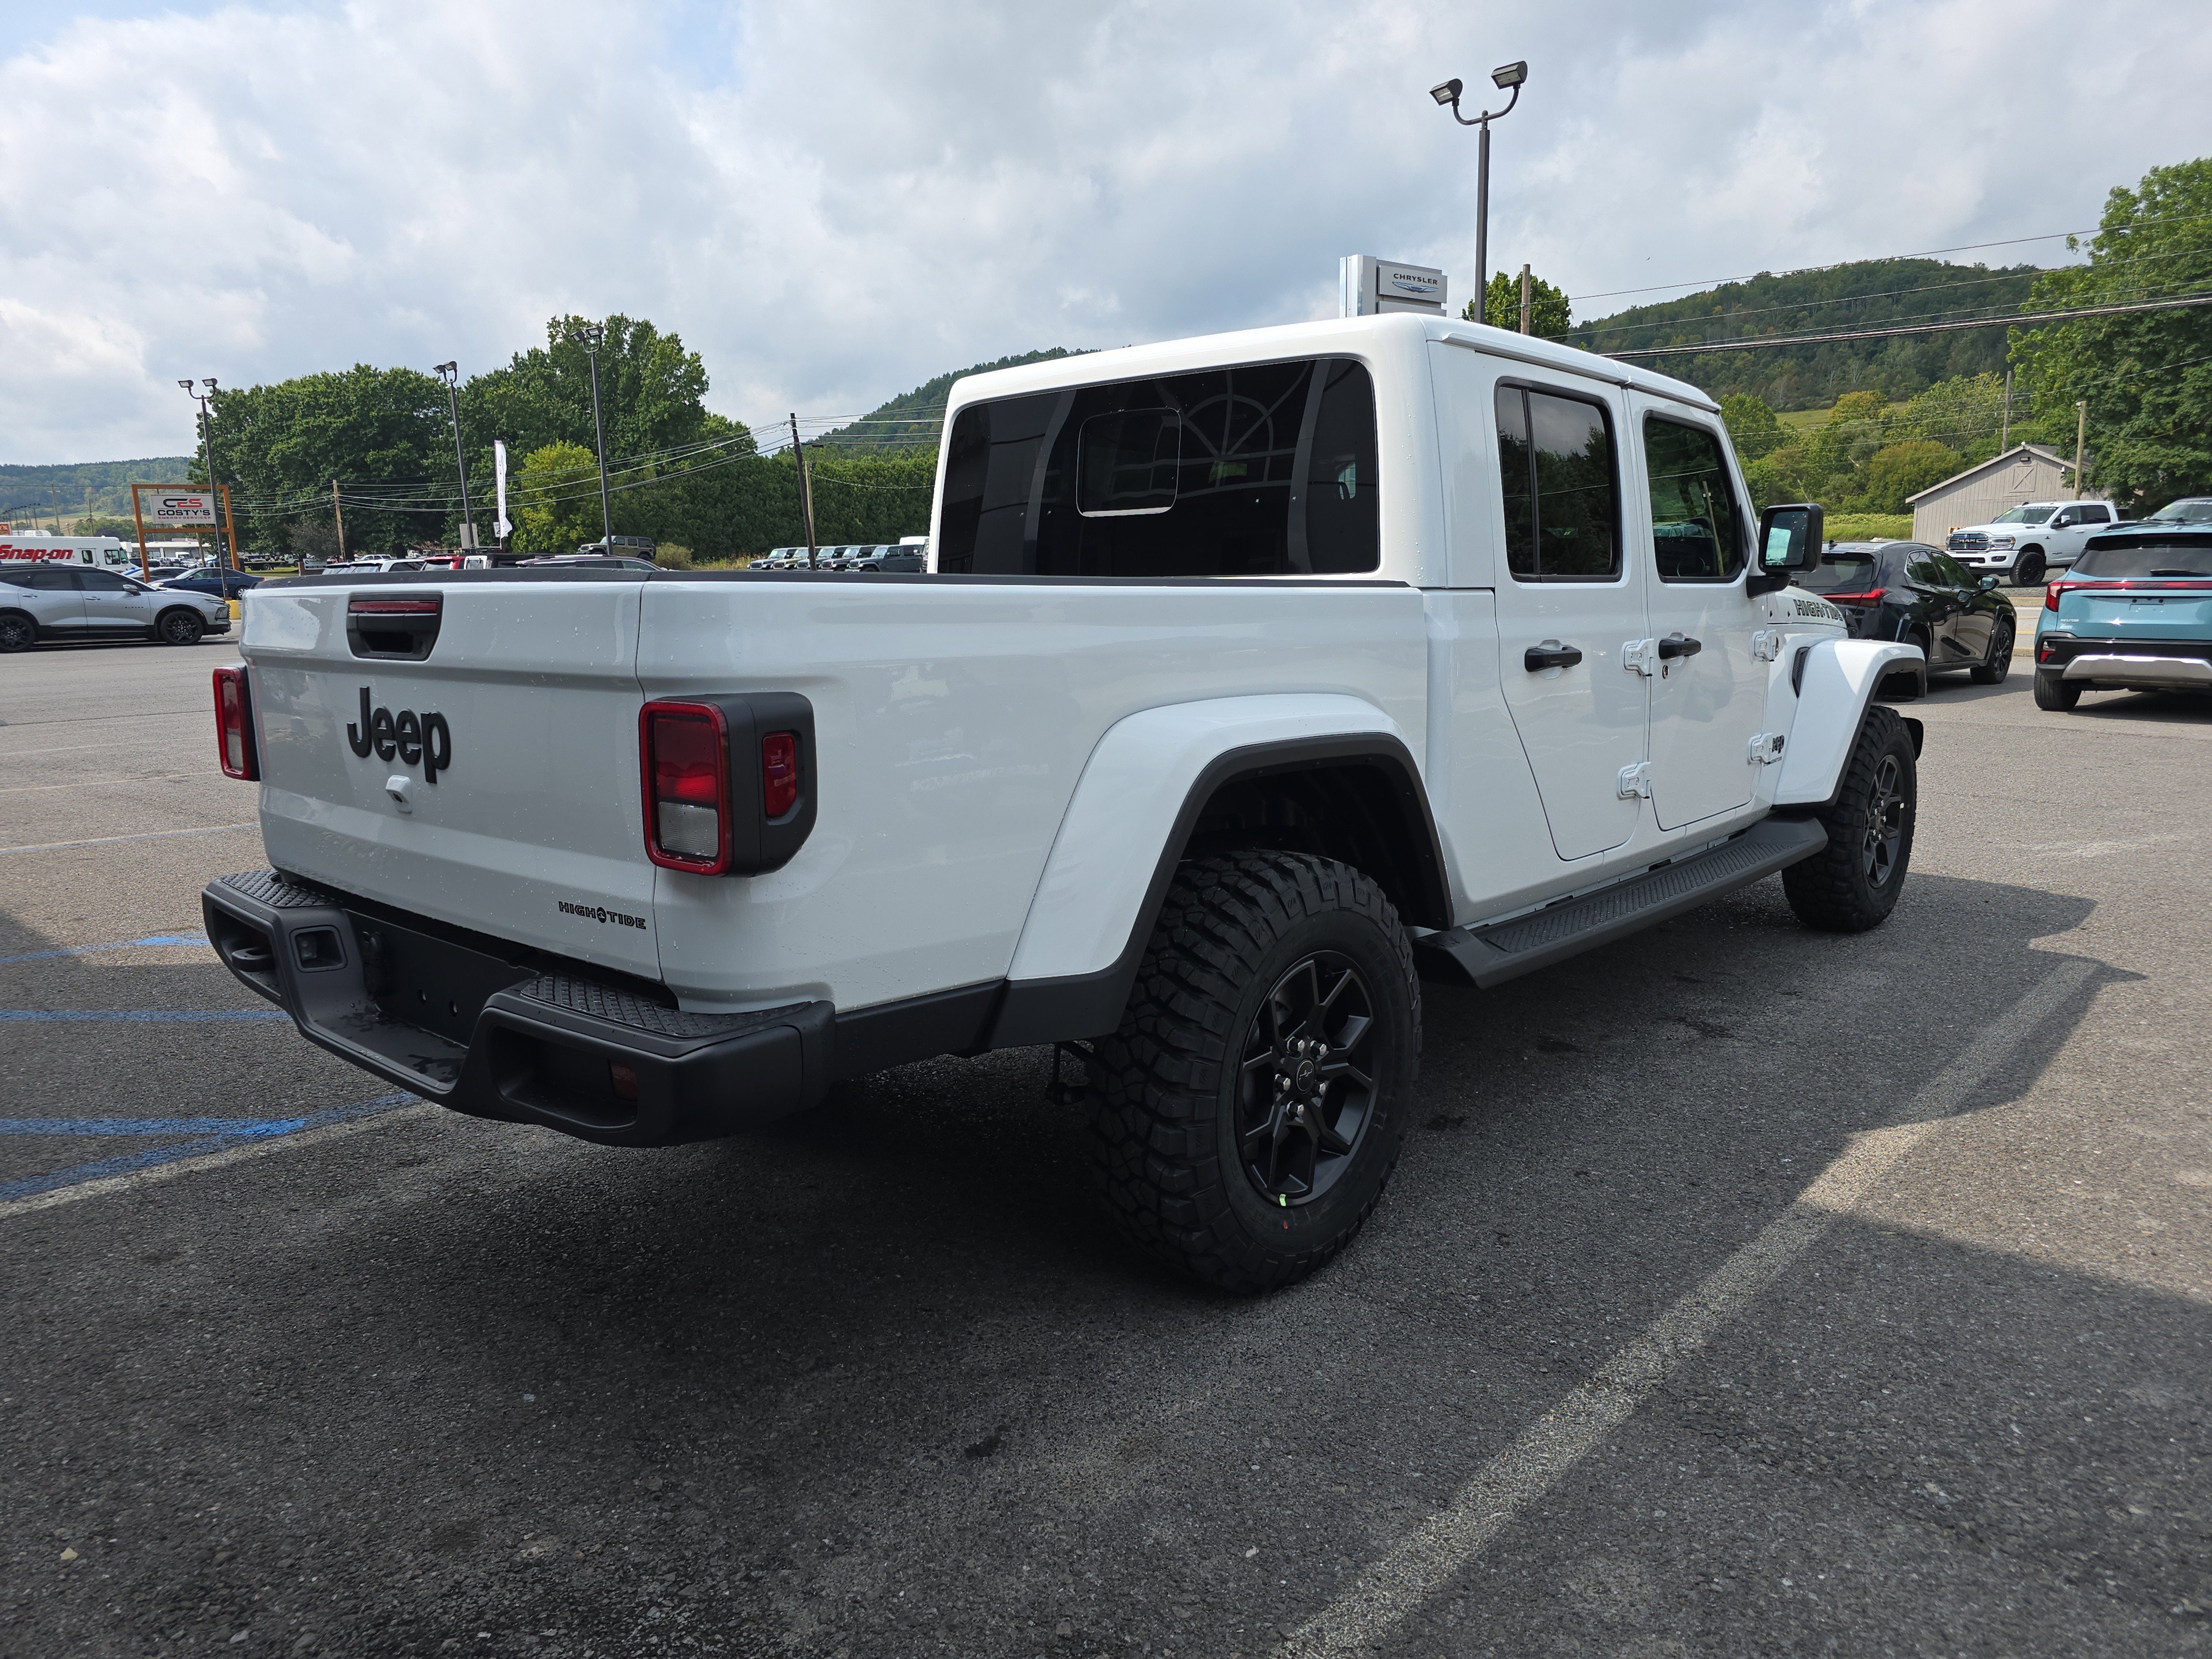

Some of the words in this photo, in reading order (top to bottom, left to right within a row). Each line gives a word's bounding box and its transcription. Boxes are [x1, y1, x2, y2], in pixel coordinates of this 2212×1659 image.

[1393, 273, 1438, 285] CHRYSLER
[163, 498, 203, 507] CES
[0, 544, 73, 562] Snap-on
[1793, 599, 1824, 618] HIGH
[346, 686, 451, 784] Jeep
[1772, 735, 1784, 754] eep
[558, 901, 596, 918] HIGH
[607, 911, 646, 929] TIDE
